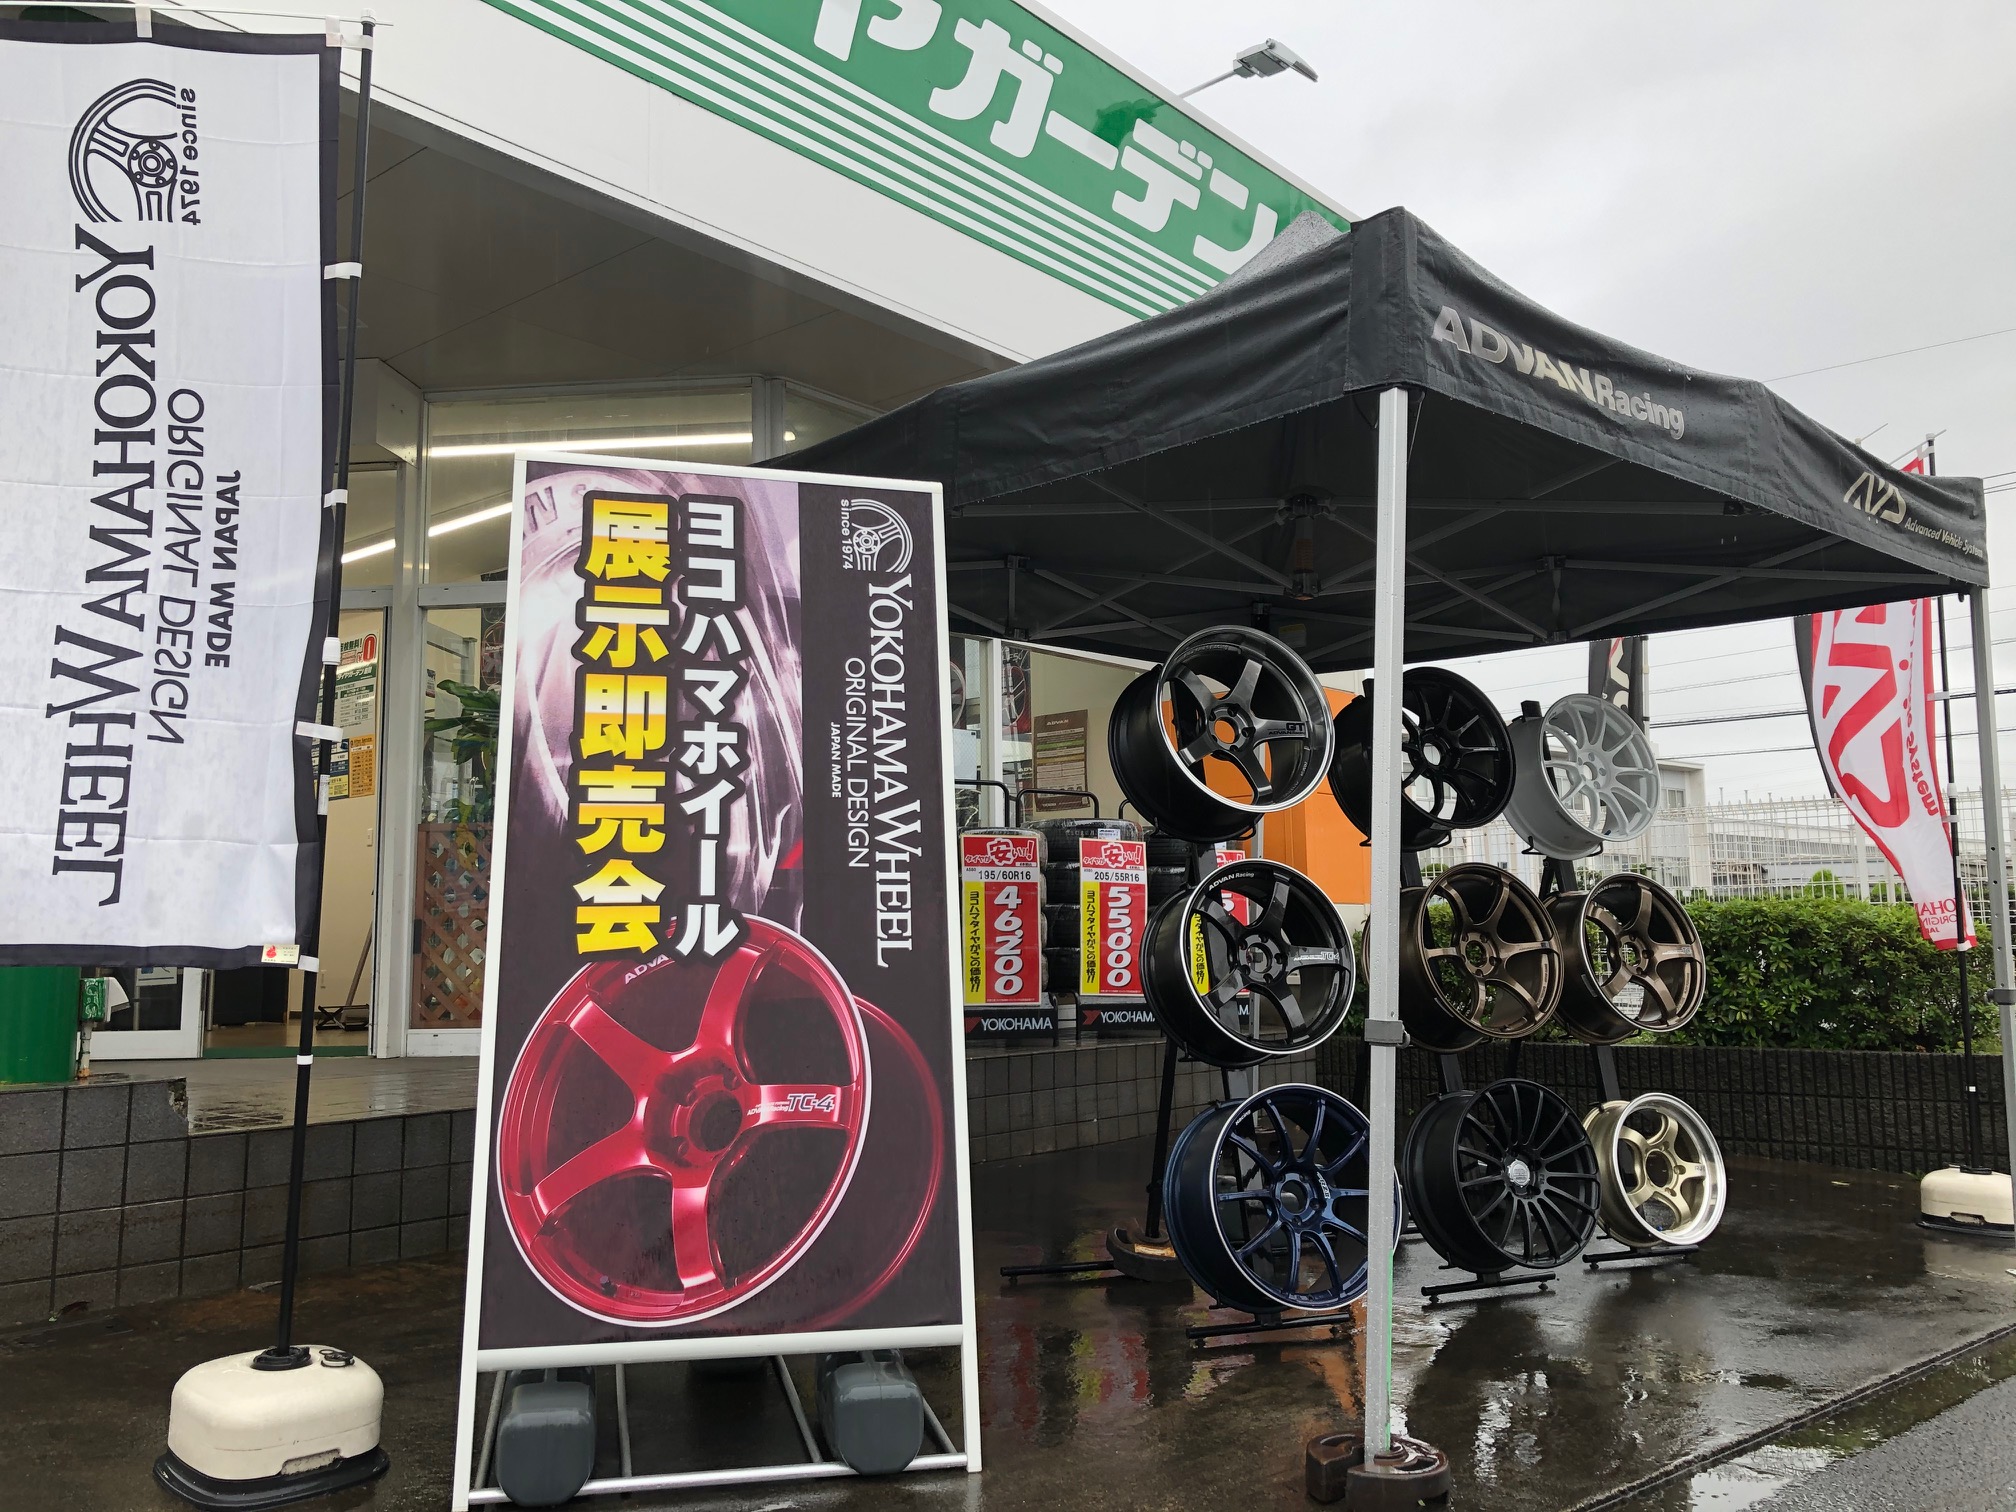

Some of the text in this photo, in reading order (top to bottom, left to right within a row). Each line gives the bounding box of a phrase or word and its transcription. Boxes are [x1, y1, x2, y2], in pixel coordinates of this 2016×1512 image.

[841, 499, 854, 570] since 1974
[1904, 517, 1942, 540] Advanced
[573, 499, 672, 954] 展示即売会
[676, 502, 742, 956] ヨコハマホイール
[830, 721, 842, 798] JAPAN MADE
[845, 657, 870, 867] ORIGINAL DESIGN
[978, 870, 1032, 881] 195/60R16
[1094, 871, 1140, 883] 205/55R16
[1208, 873, 1235, 892] ADVAN
[993, 885, 1024, 996] 46,200
[1107, 886, 1133, 988] 55,000
[625, 953, 670, 985] ADVA
[981, 1016, 1053, 1031] YOKOHAMA
[1100, 1009, 1155, 1024] YOKOHAM
[787, 1093, 837, 1113] TC-4
